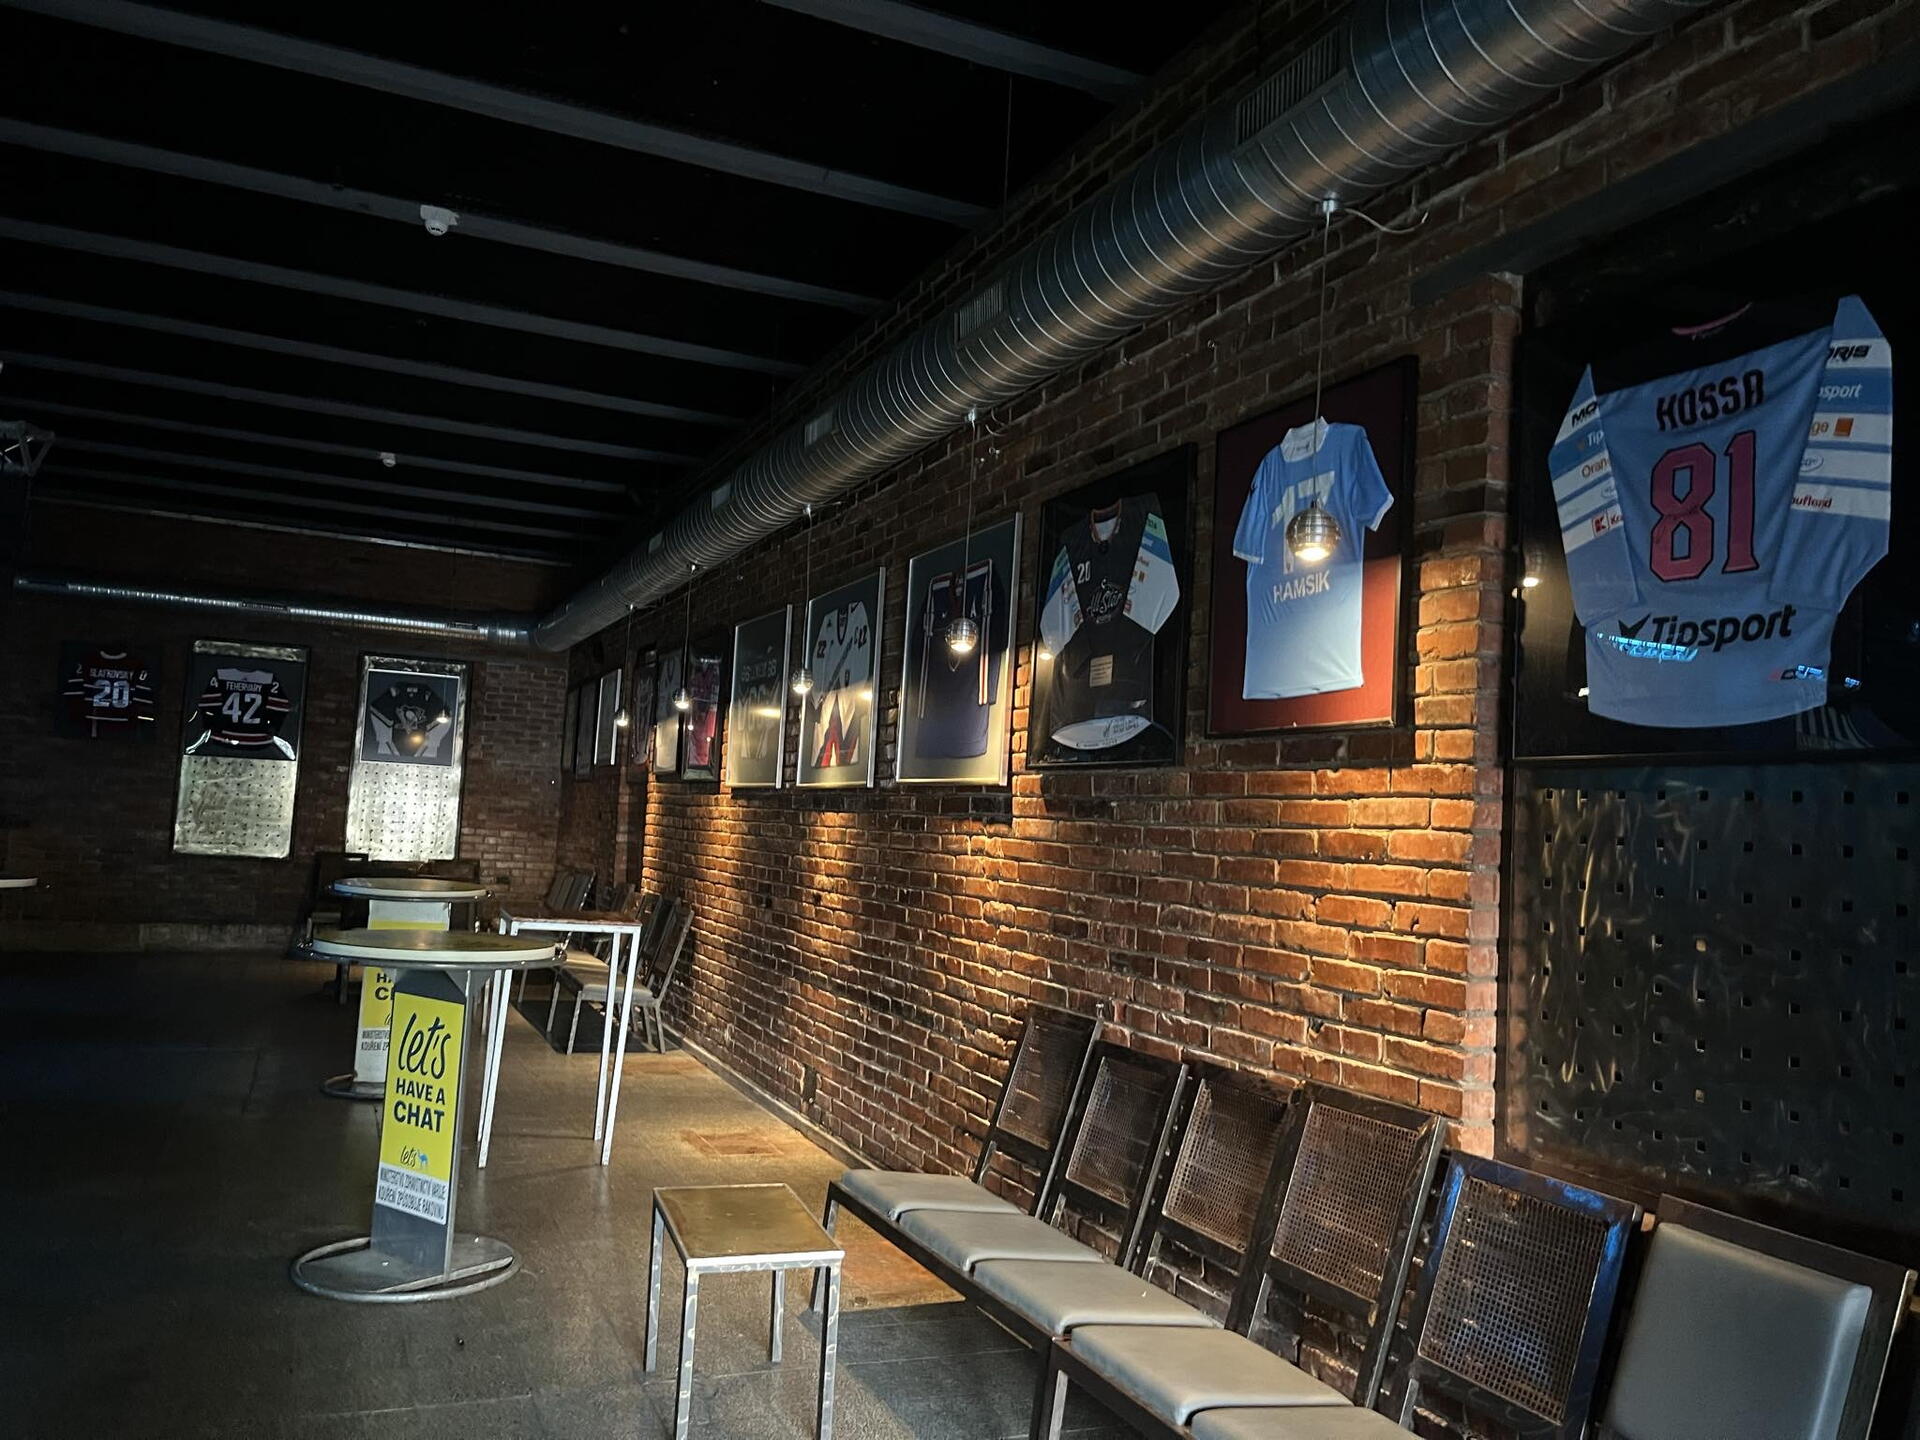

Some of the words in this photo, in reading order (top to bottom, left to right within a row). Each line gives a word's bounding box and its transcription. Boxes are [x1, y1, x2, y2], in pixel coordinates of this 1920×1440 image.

[1657, 369, 1764, 431] HOSSA
[1650, 430, 1760, 582] 81
[1273, 569, 1330, 604] HAMSIK
[1651, 604, 1797, 652] Tipsport
[92, 679, 130, 709] 20
[270, 681, 280, 694] 2
[222, 691, 263, 725] 42
[396, 1077, 433, 1102] HAVE
[435, 1087, 446, 1106] A
[393, 1100, 445, 1133] CHAT
